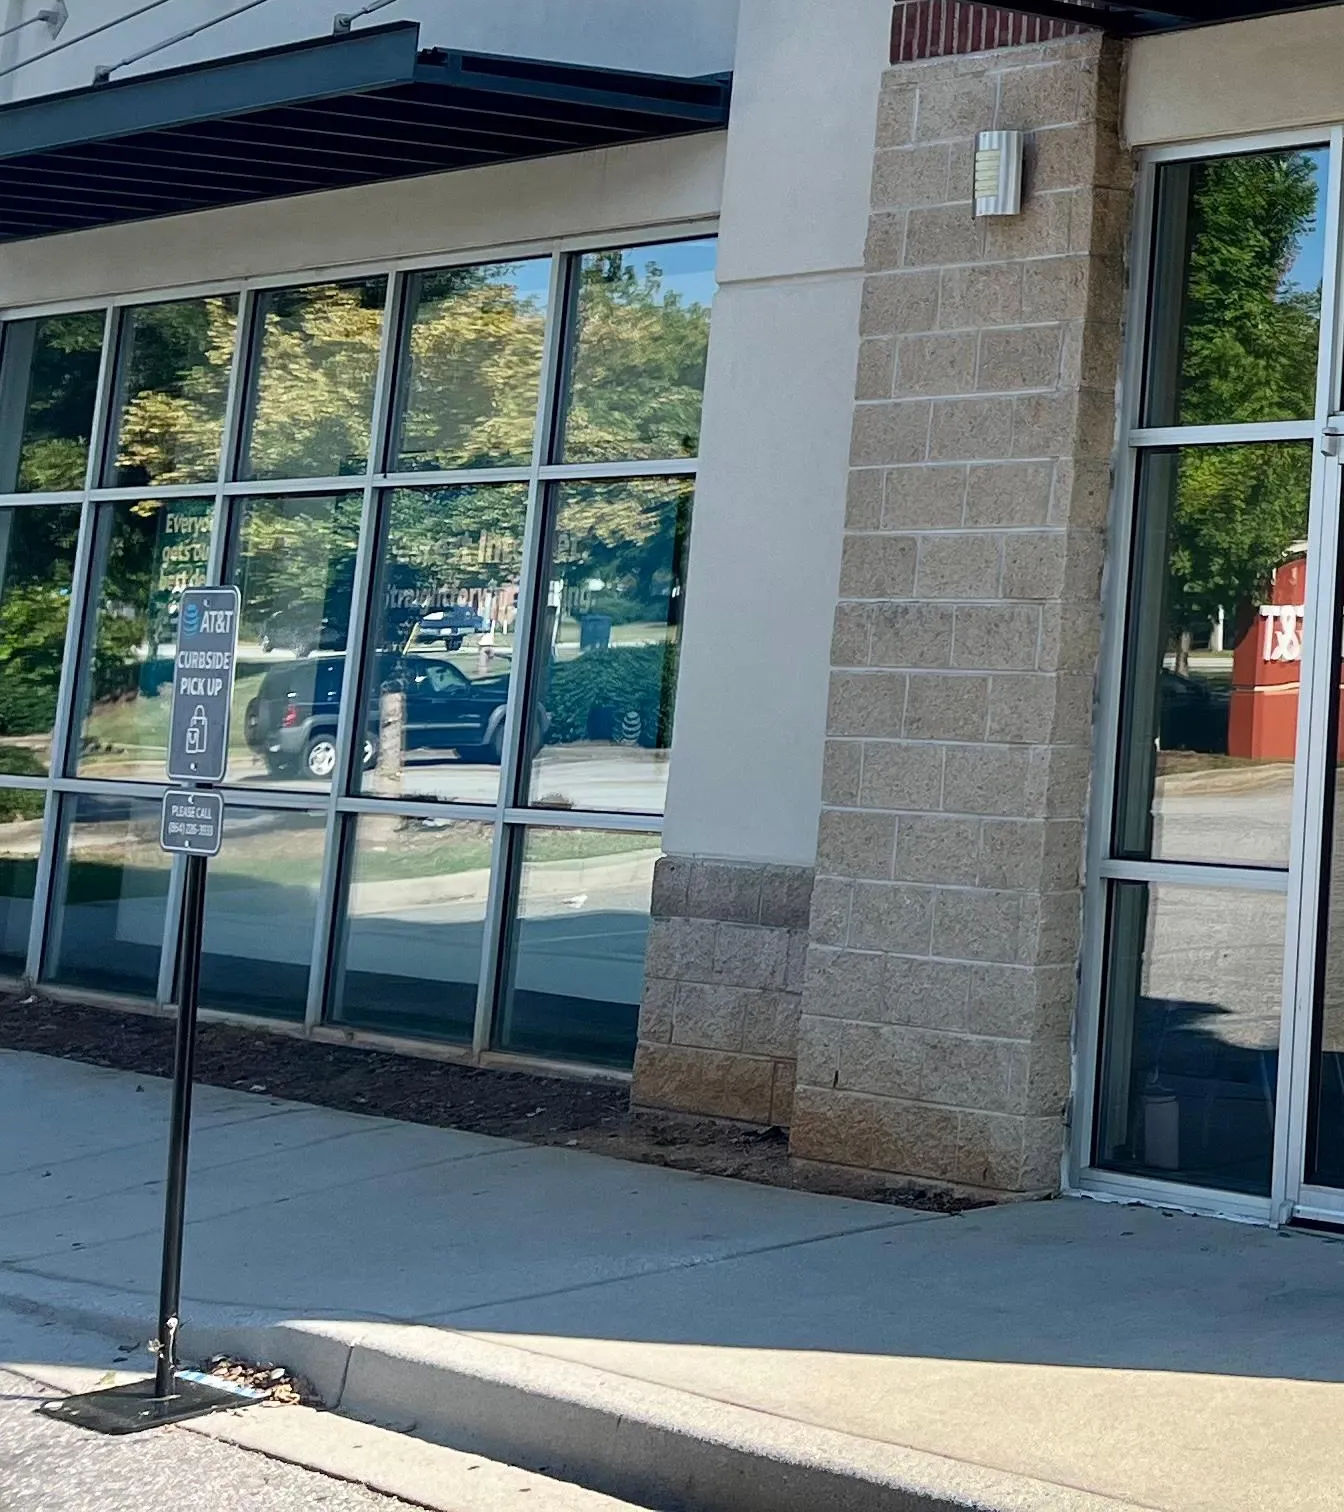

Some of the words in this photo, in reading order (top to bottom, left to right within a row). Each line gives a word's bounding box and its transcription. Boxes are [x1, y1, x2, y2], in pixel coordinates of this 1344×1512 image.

[199, 609, 234, 634] AT&T
[177, 650, 231, 670] CURBSIDE
[179, 677, 206, 696] PICK
[207, 678, 223, 697] UP
[171, 805, 196, 819] PLEASE
[195, 807, 213, 820] CALL
